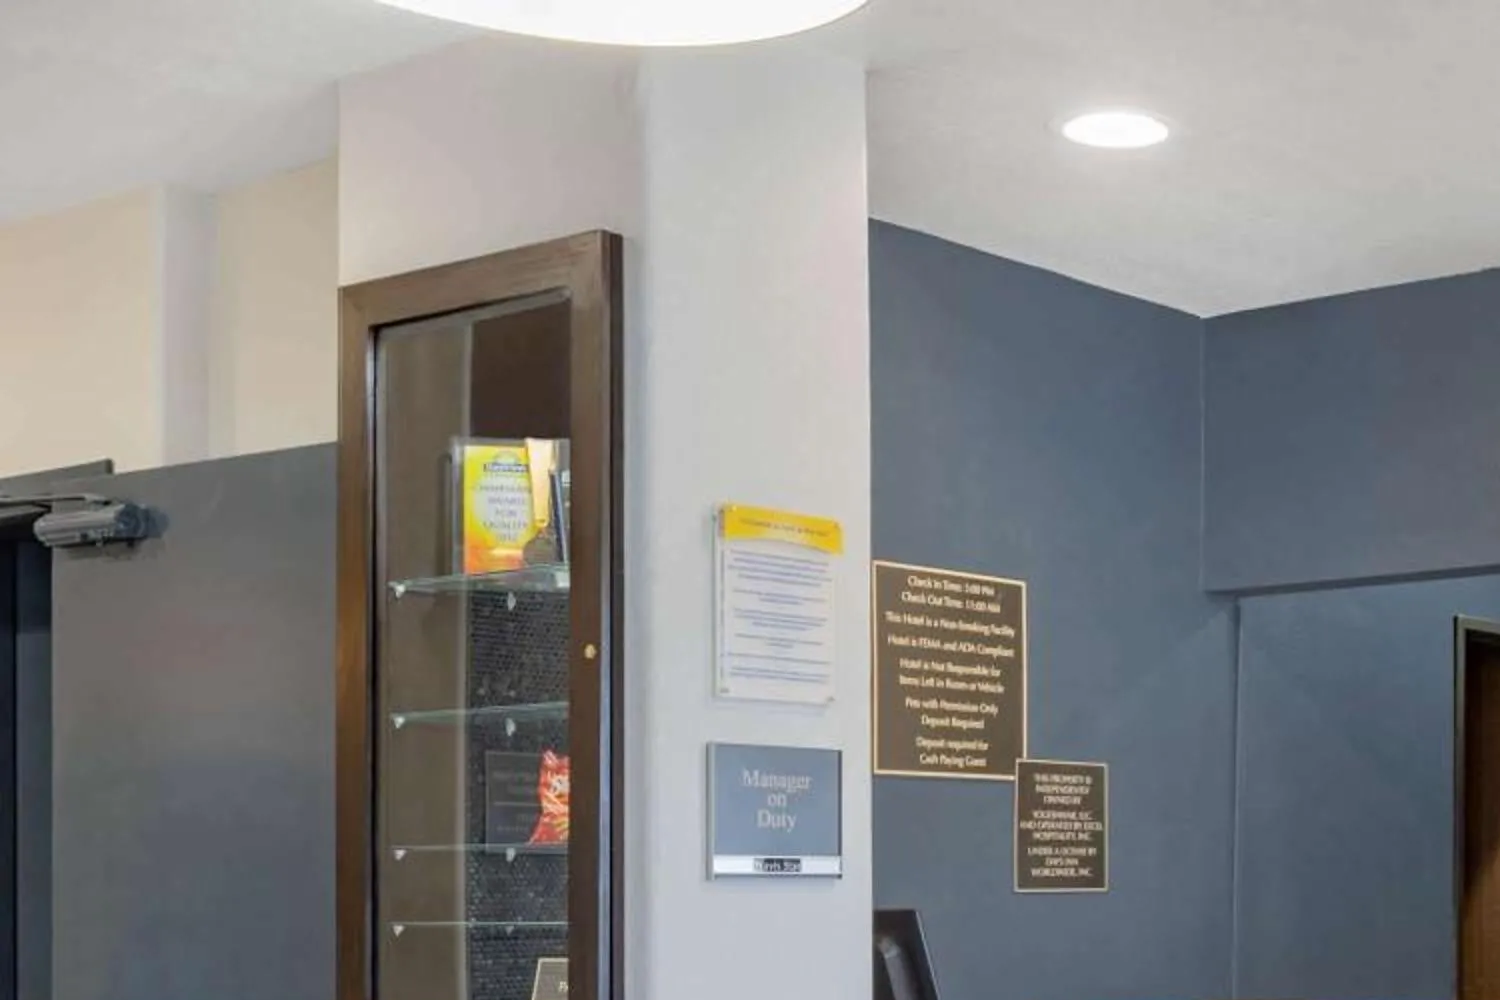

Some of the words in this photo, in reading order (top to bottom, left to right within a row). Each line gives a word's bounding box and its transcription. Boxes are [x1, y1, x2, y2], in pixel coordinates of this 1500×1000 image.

[907, 575, 933, 589] Check
[901, 591, 926, 604] Check
[927, 594, 943, 606] Out
[903, 613, 925, 626] Hotel
[741, 766, 813, 794] Manager
[767, 792, 788, 807] on
[757, 808, 798, 834] Duty
